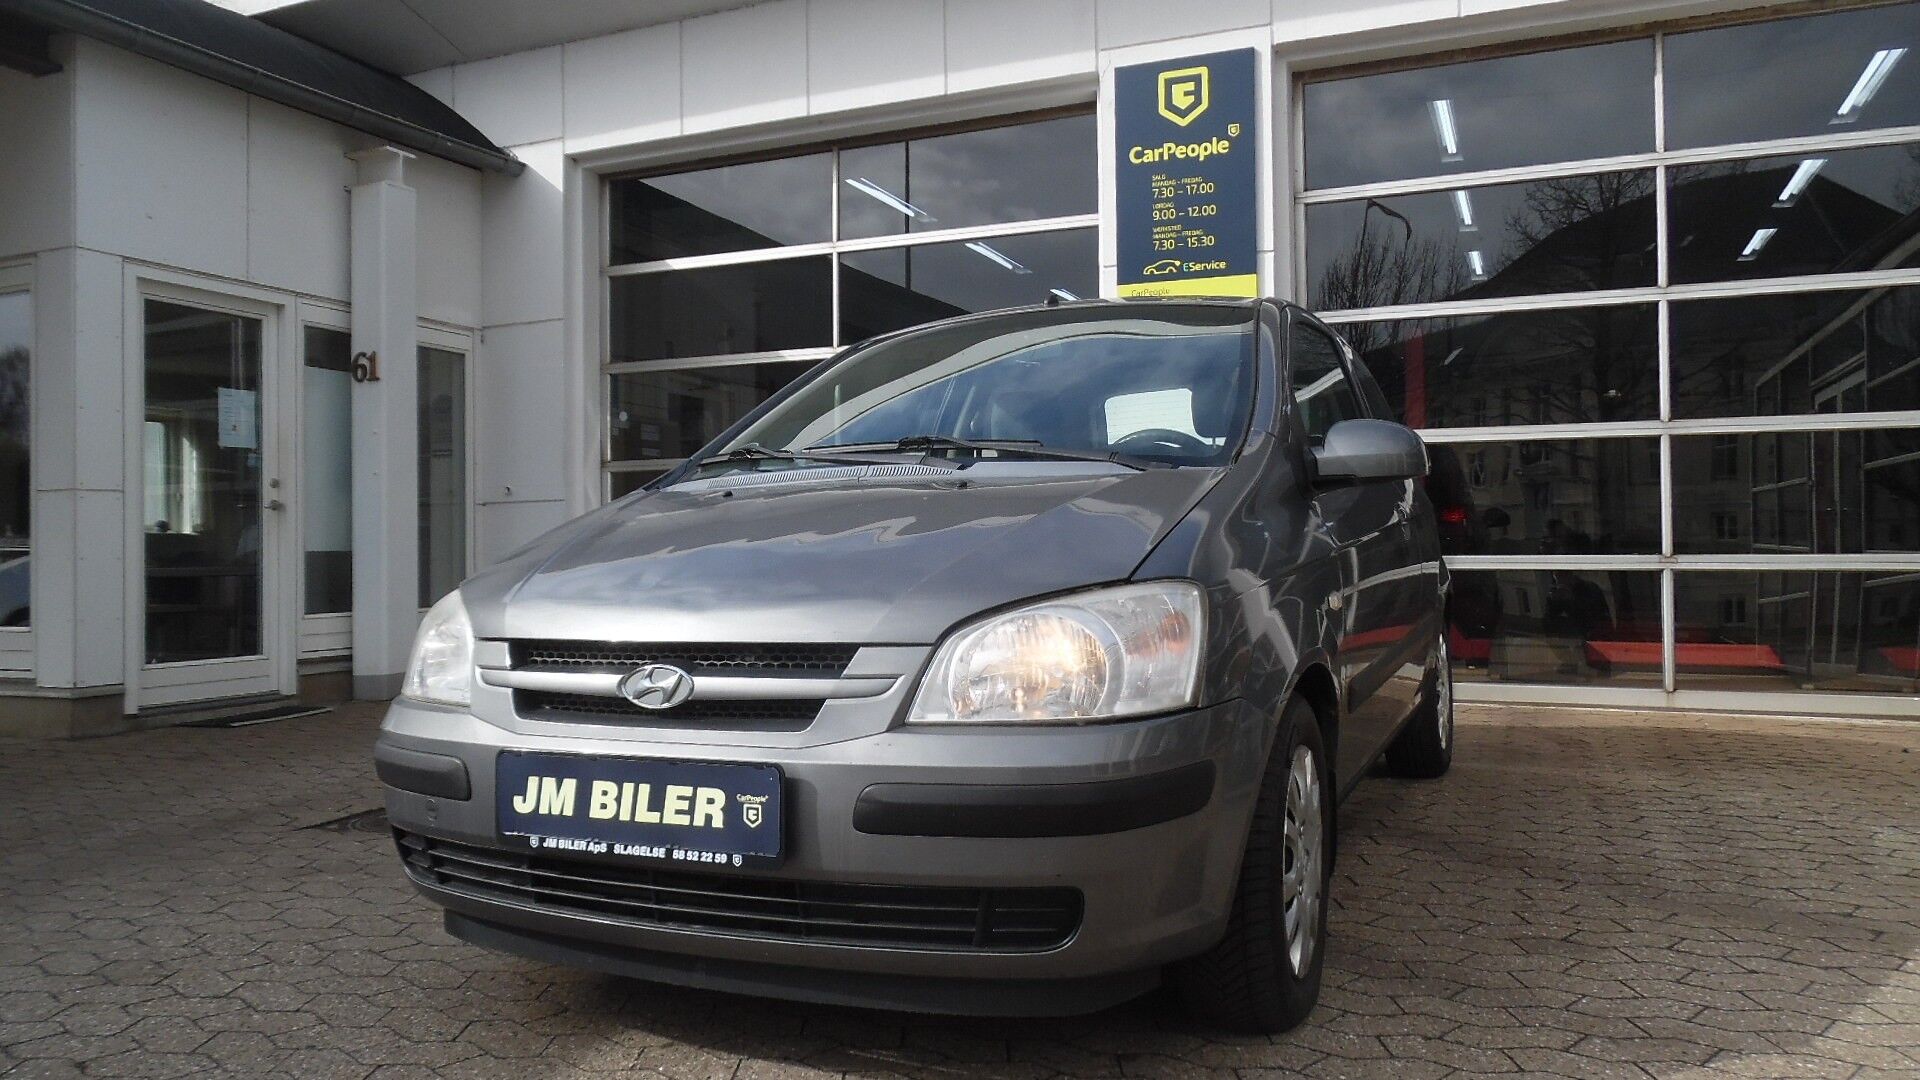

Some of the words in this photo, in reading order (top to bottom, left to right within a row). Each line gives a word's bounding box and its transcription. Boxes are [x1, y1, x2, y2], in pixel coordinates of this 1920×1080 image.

[1129, 137, 1230, 164] CarPeople
[1152, 186, 1174, 199] 7.30
[1186, 182, 1214, 196] 17.00
[1152, 208, 1176, 221] 9.00
[1188, 204, 1217, 217] 12.00
[1153, 239, 1175, 251] 7.30
[1186, 235, 1215, 248] 15.30
[351, 350, 380, 383] 61
[512, 775, 577, 816] JM
[589, 780, 726, 828] BILER
[543, 838, 558, 848] JM
[558, 839, 587, 851] BILER
[587, 842, 608, 855] ApS
[613, 843, 666, 858] SLAGELSE
[686, 850, 699, 861] 52
[700, 851, 713, 862] 22
